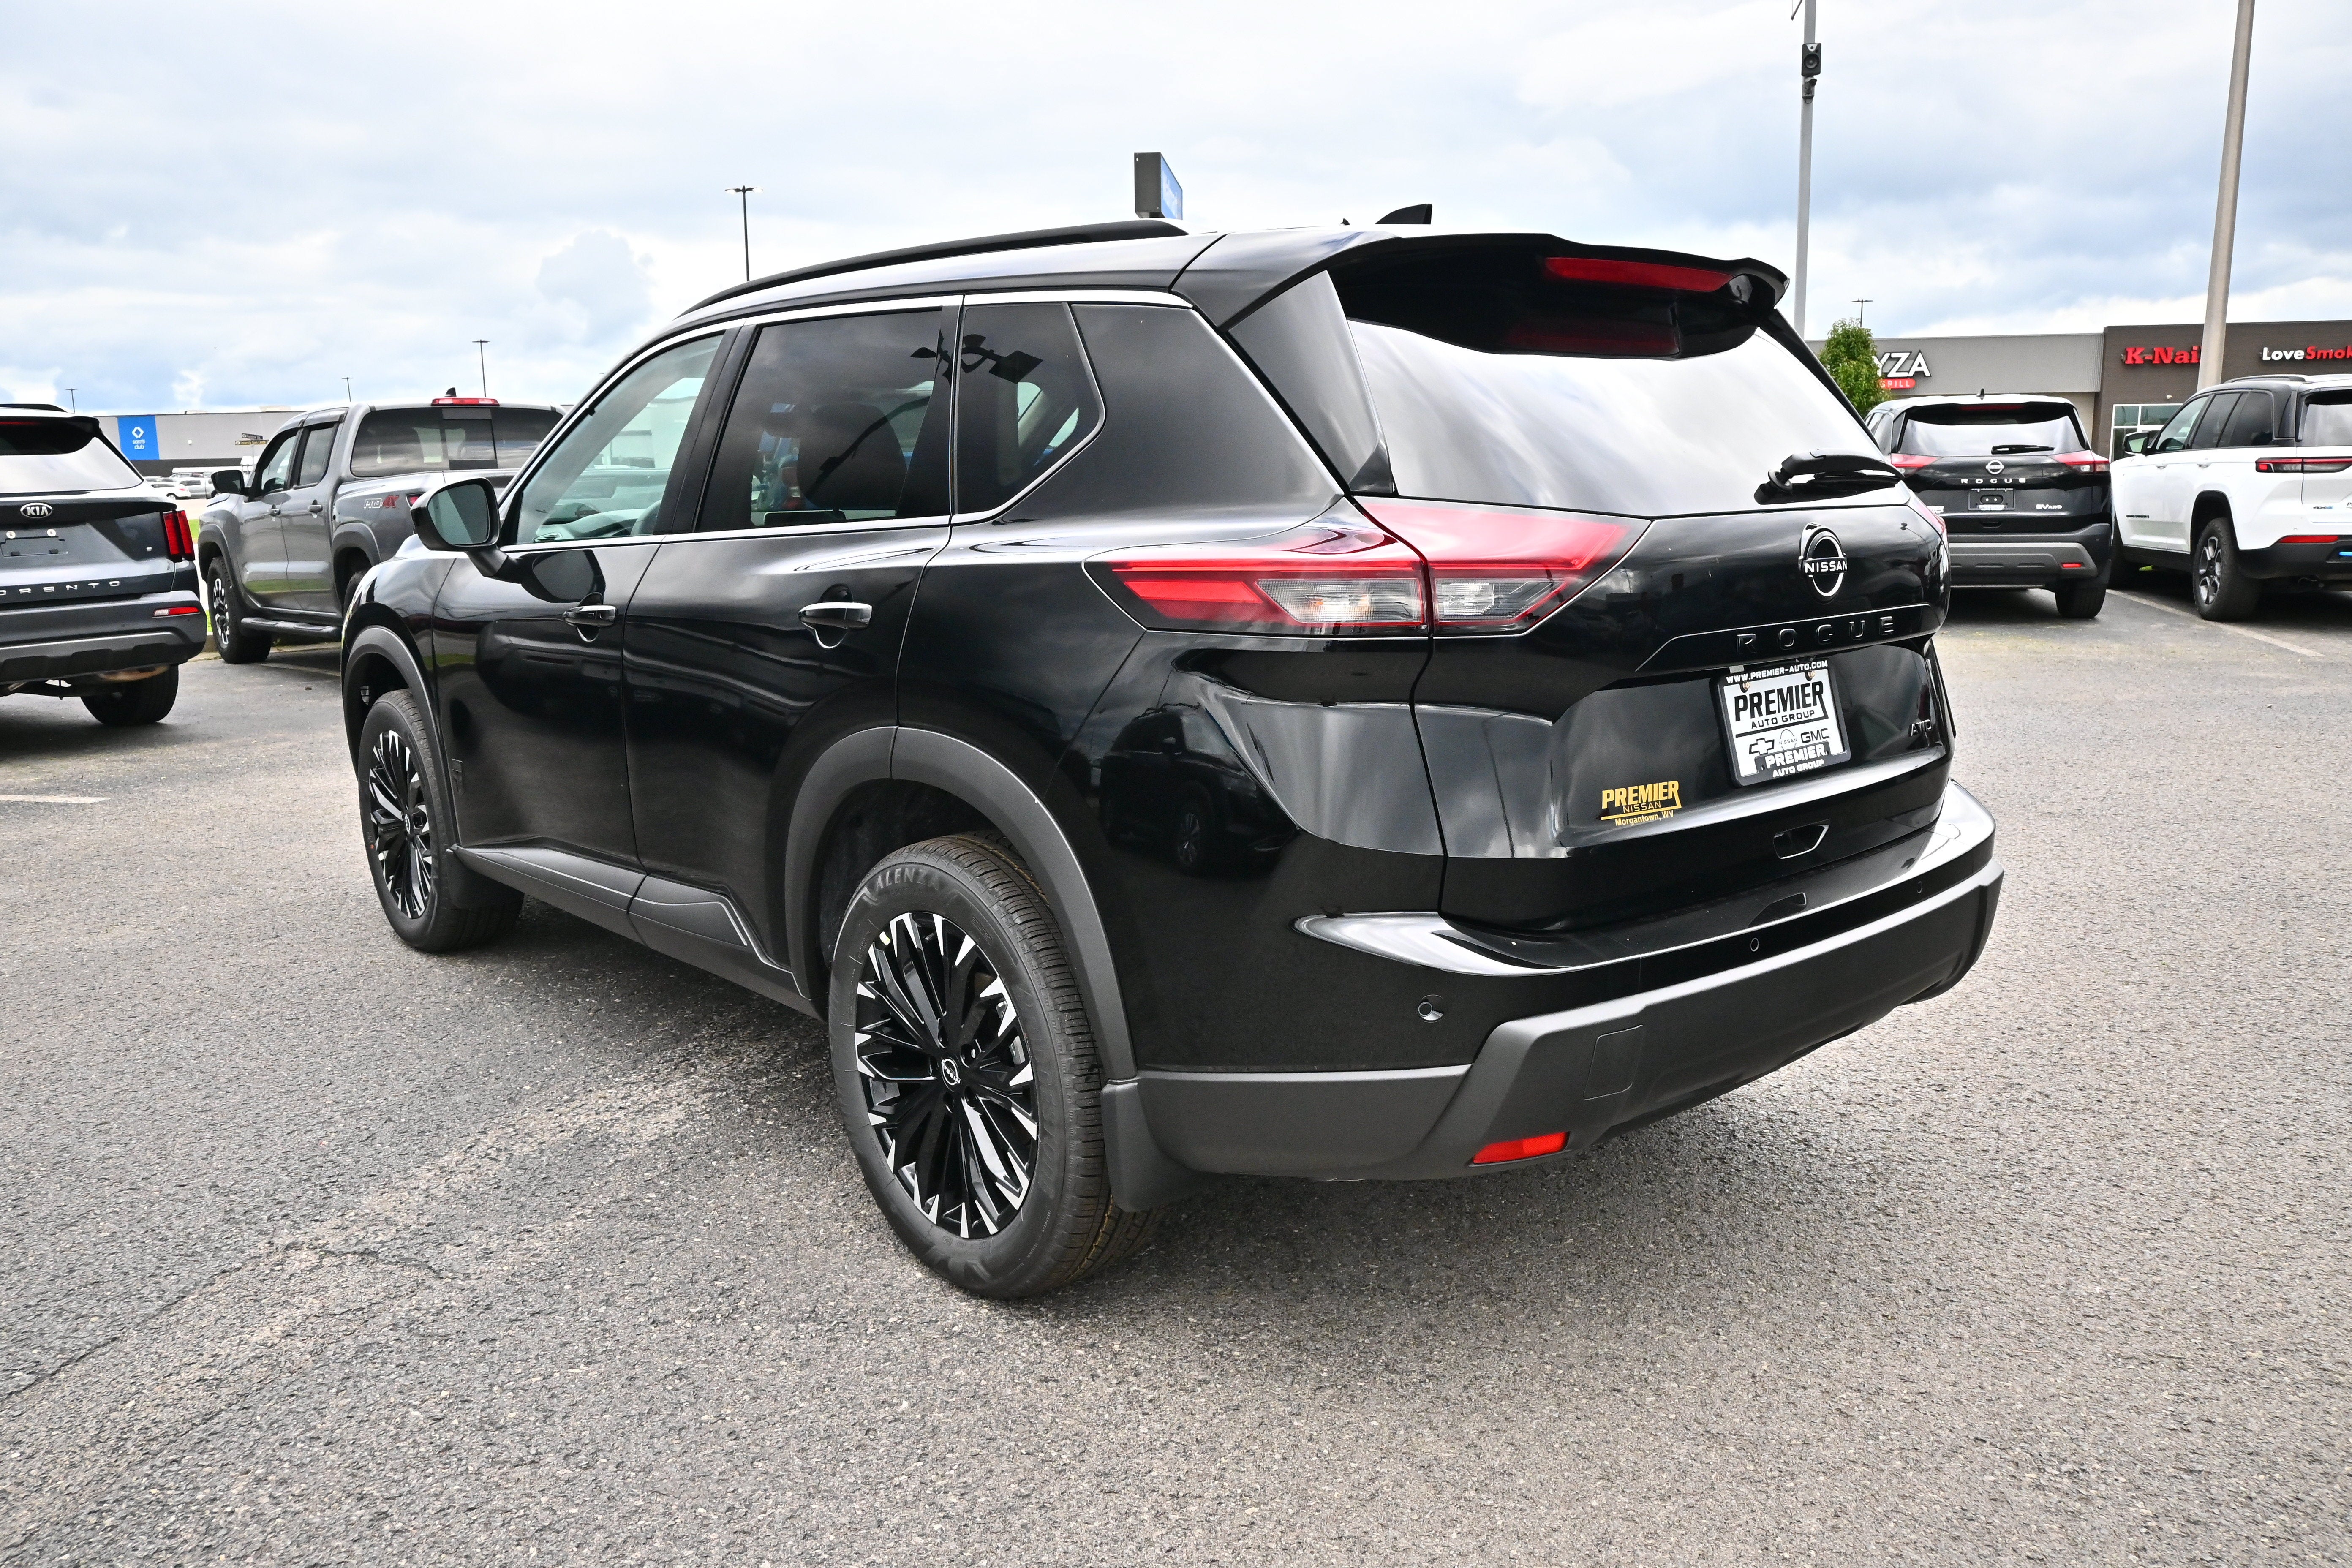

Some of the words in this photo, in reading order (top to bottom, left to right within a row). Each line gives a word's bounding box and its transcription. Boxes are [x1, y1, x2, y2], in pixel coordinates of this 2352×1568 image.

[2125, 346, 2202, 364] K-Nai
[26, 506, 49, 515] KIA
[1805, 559, 1847, 573] NISSAN
[1737, 616, 1894, 654] ROGUE
[1726, 660, 1828, 684] WWW.PREMIER-AUTO.COM
[1734, 681, 1829, 721] PREMIER
[1751, 717, 1778, 729] AUTO
[1782, 710, 1815, 722] GROUP
[1801, 727, 1830, 743] GMC
[1765, 743, 1828, 769] PREMIER
[1772, 766, 1795, 778] AUTO
[1797, 759, 1824, 771] GROUP
[1602, 780, 1682, 809] PREMIER
[1623, 801, 1661, 813] NISSAN
[1615, 814, 1661, 826] Morgantown,
[1661, 810, 1674, 819] WV
